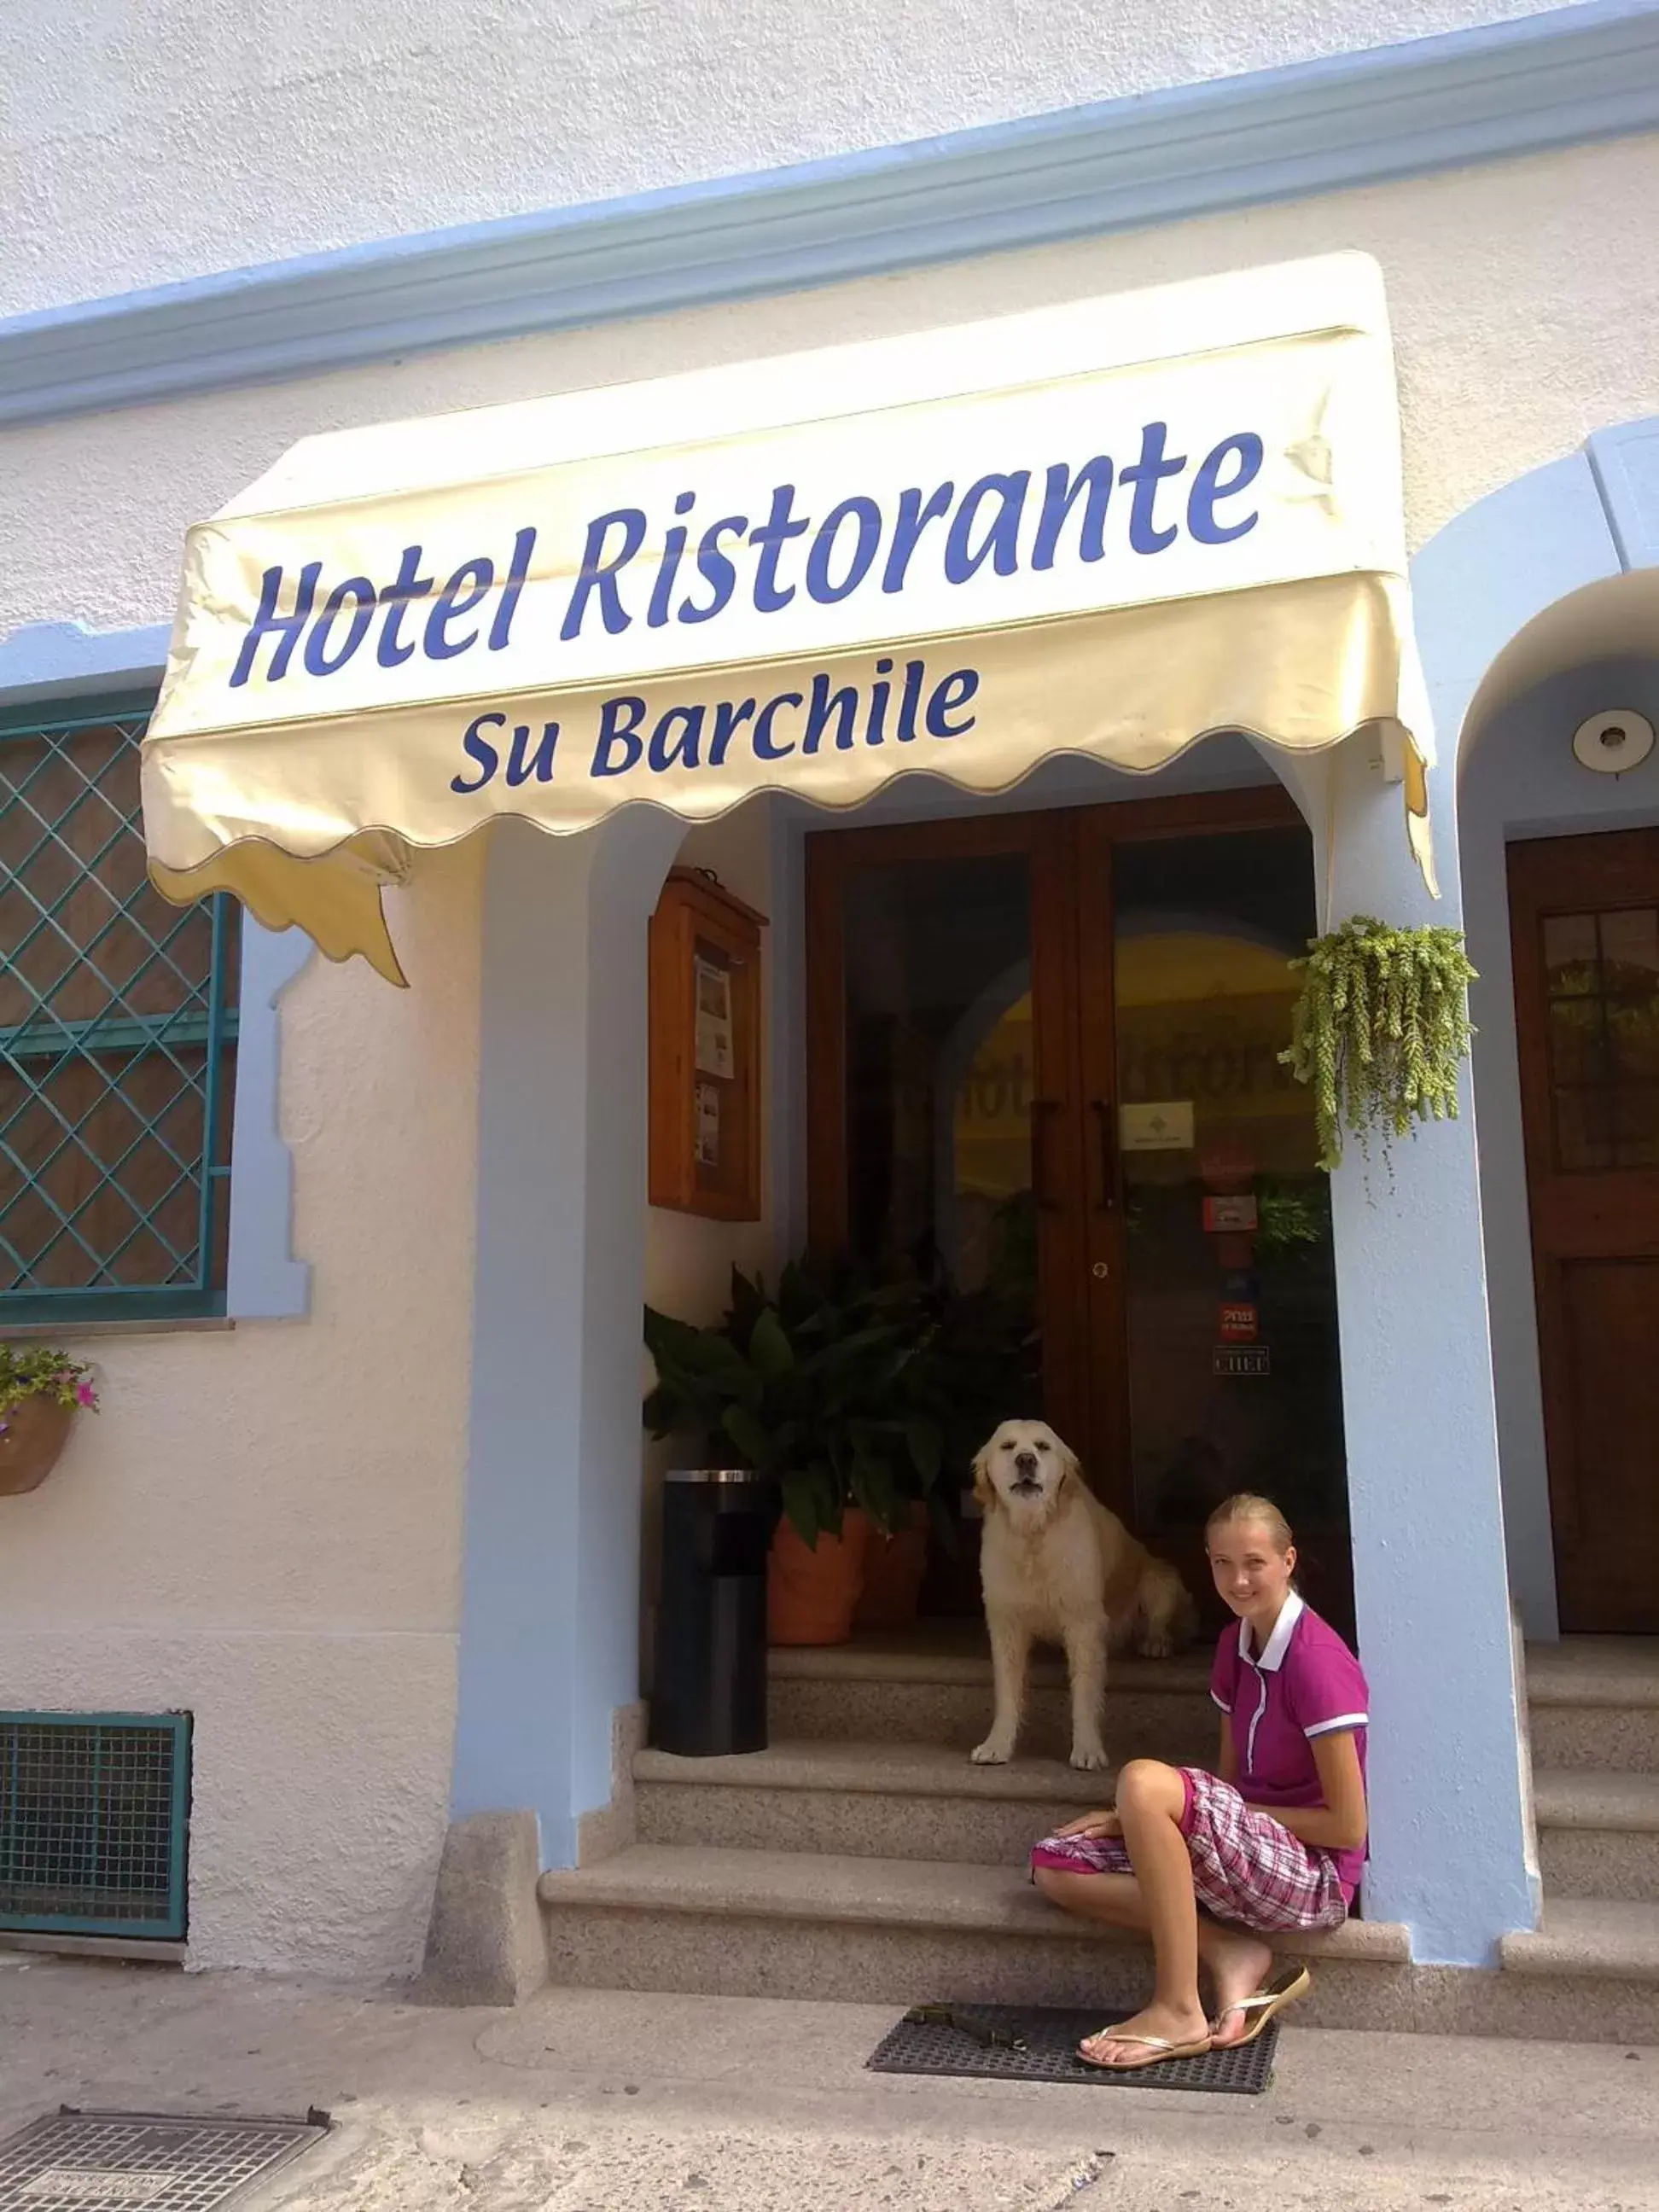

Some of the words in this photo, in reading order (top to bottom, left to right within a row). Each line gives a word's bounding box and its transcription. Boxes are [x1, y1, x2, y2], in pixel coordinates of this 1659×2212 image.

[229, 526, 538, 689] Hotel
[559, 421, 1265, 643] Ristorante
[450, 711, 560, 795] Su
[589, 656, 981, 779] Barchile
